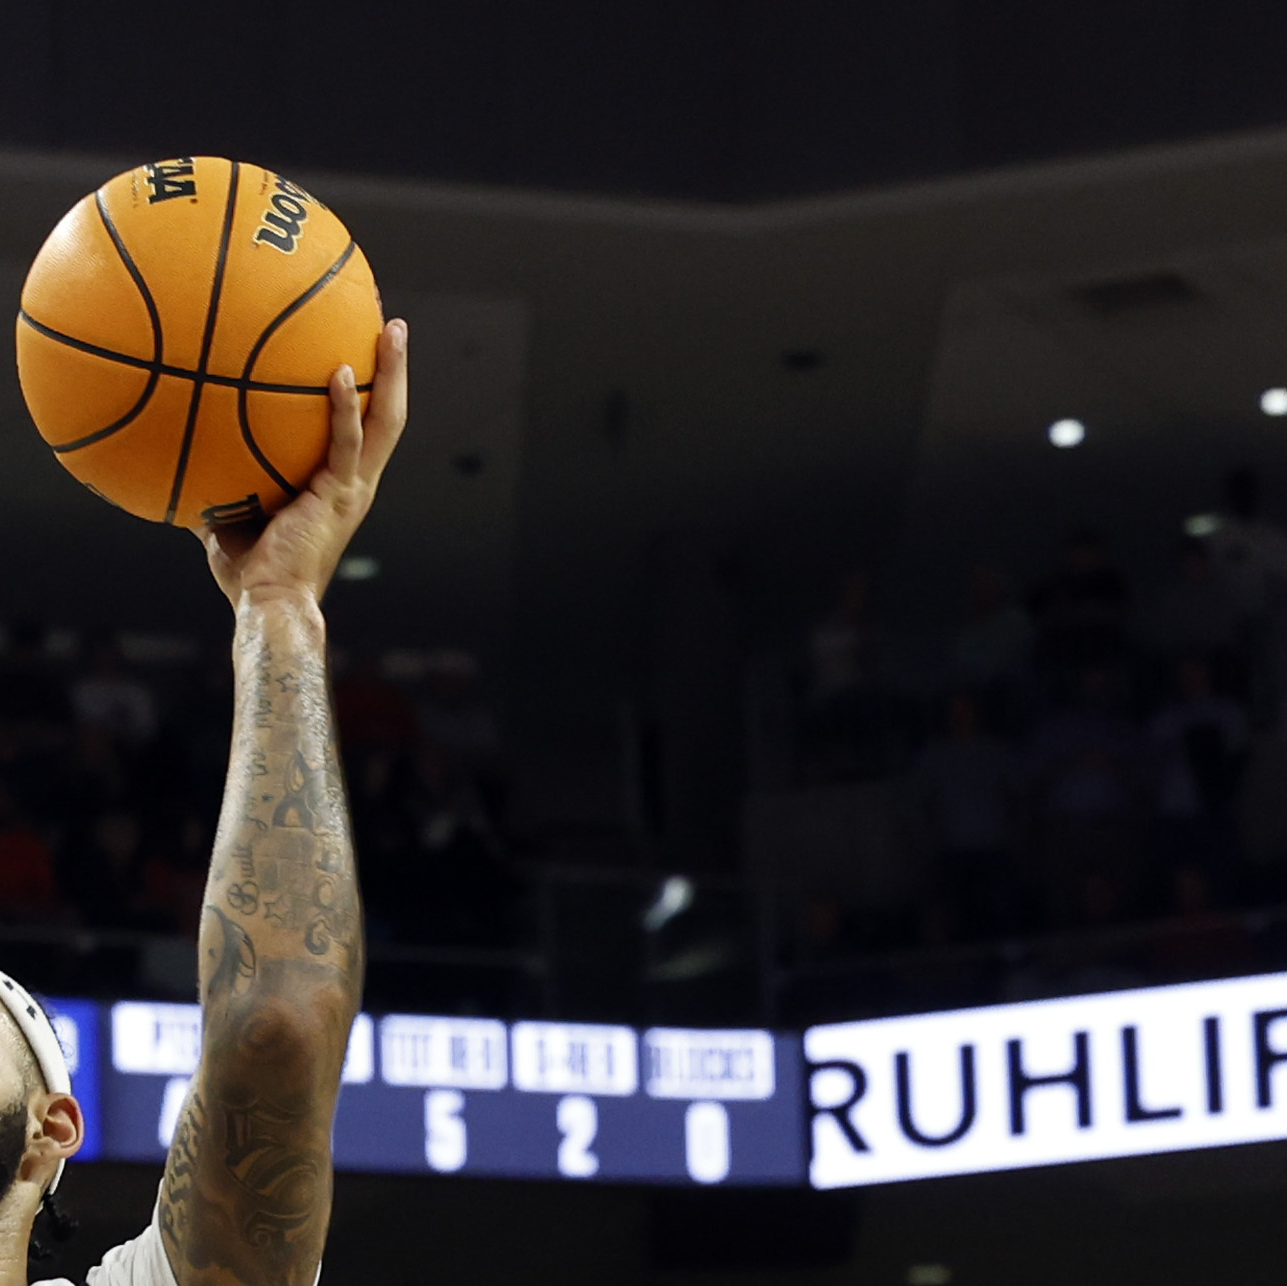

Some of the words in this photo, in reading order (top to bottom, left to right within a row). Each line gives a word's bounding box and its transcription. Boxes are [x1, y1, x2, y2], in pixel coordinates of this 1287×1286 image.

[426, 1089, 467, 1171] 5
[557, 1095, 598, 1177] 2
[685, 1101, 730, 1183] 0
